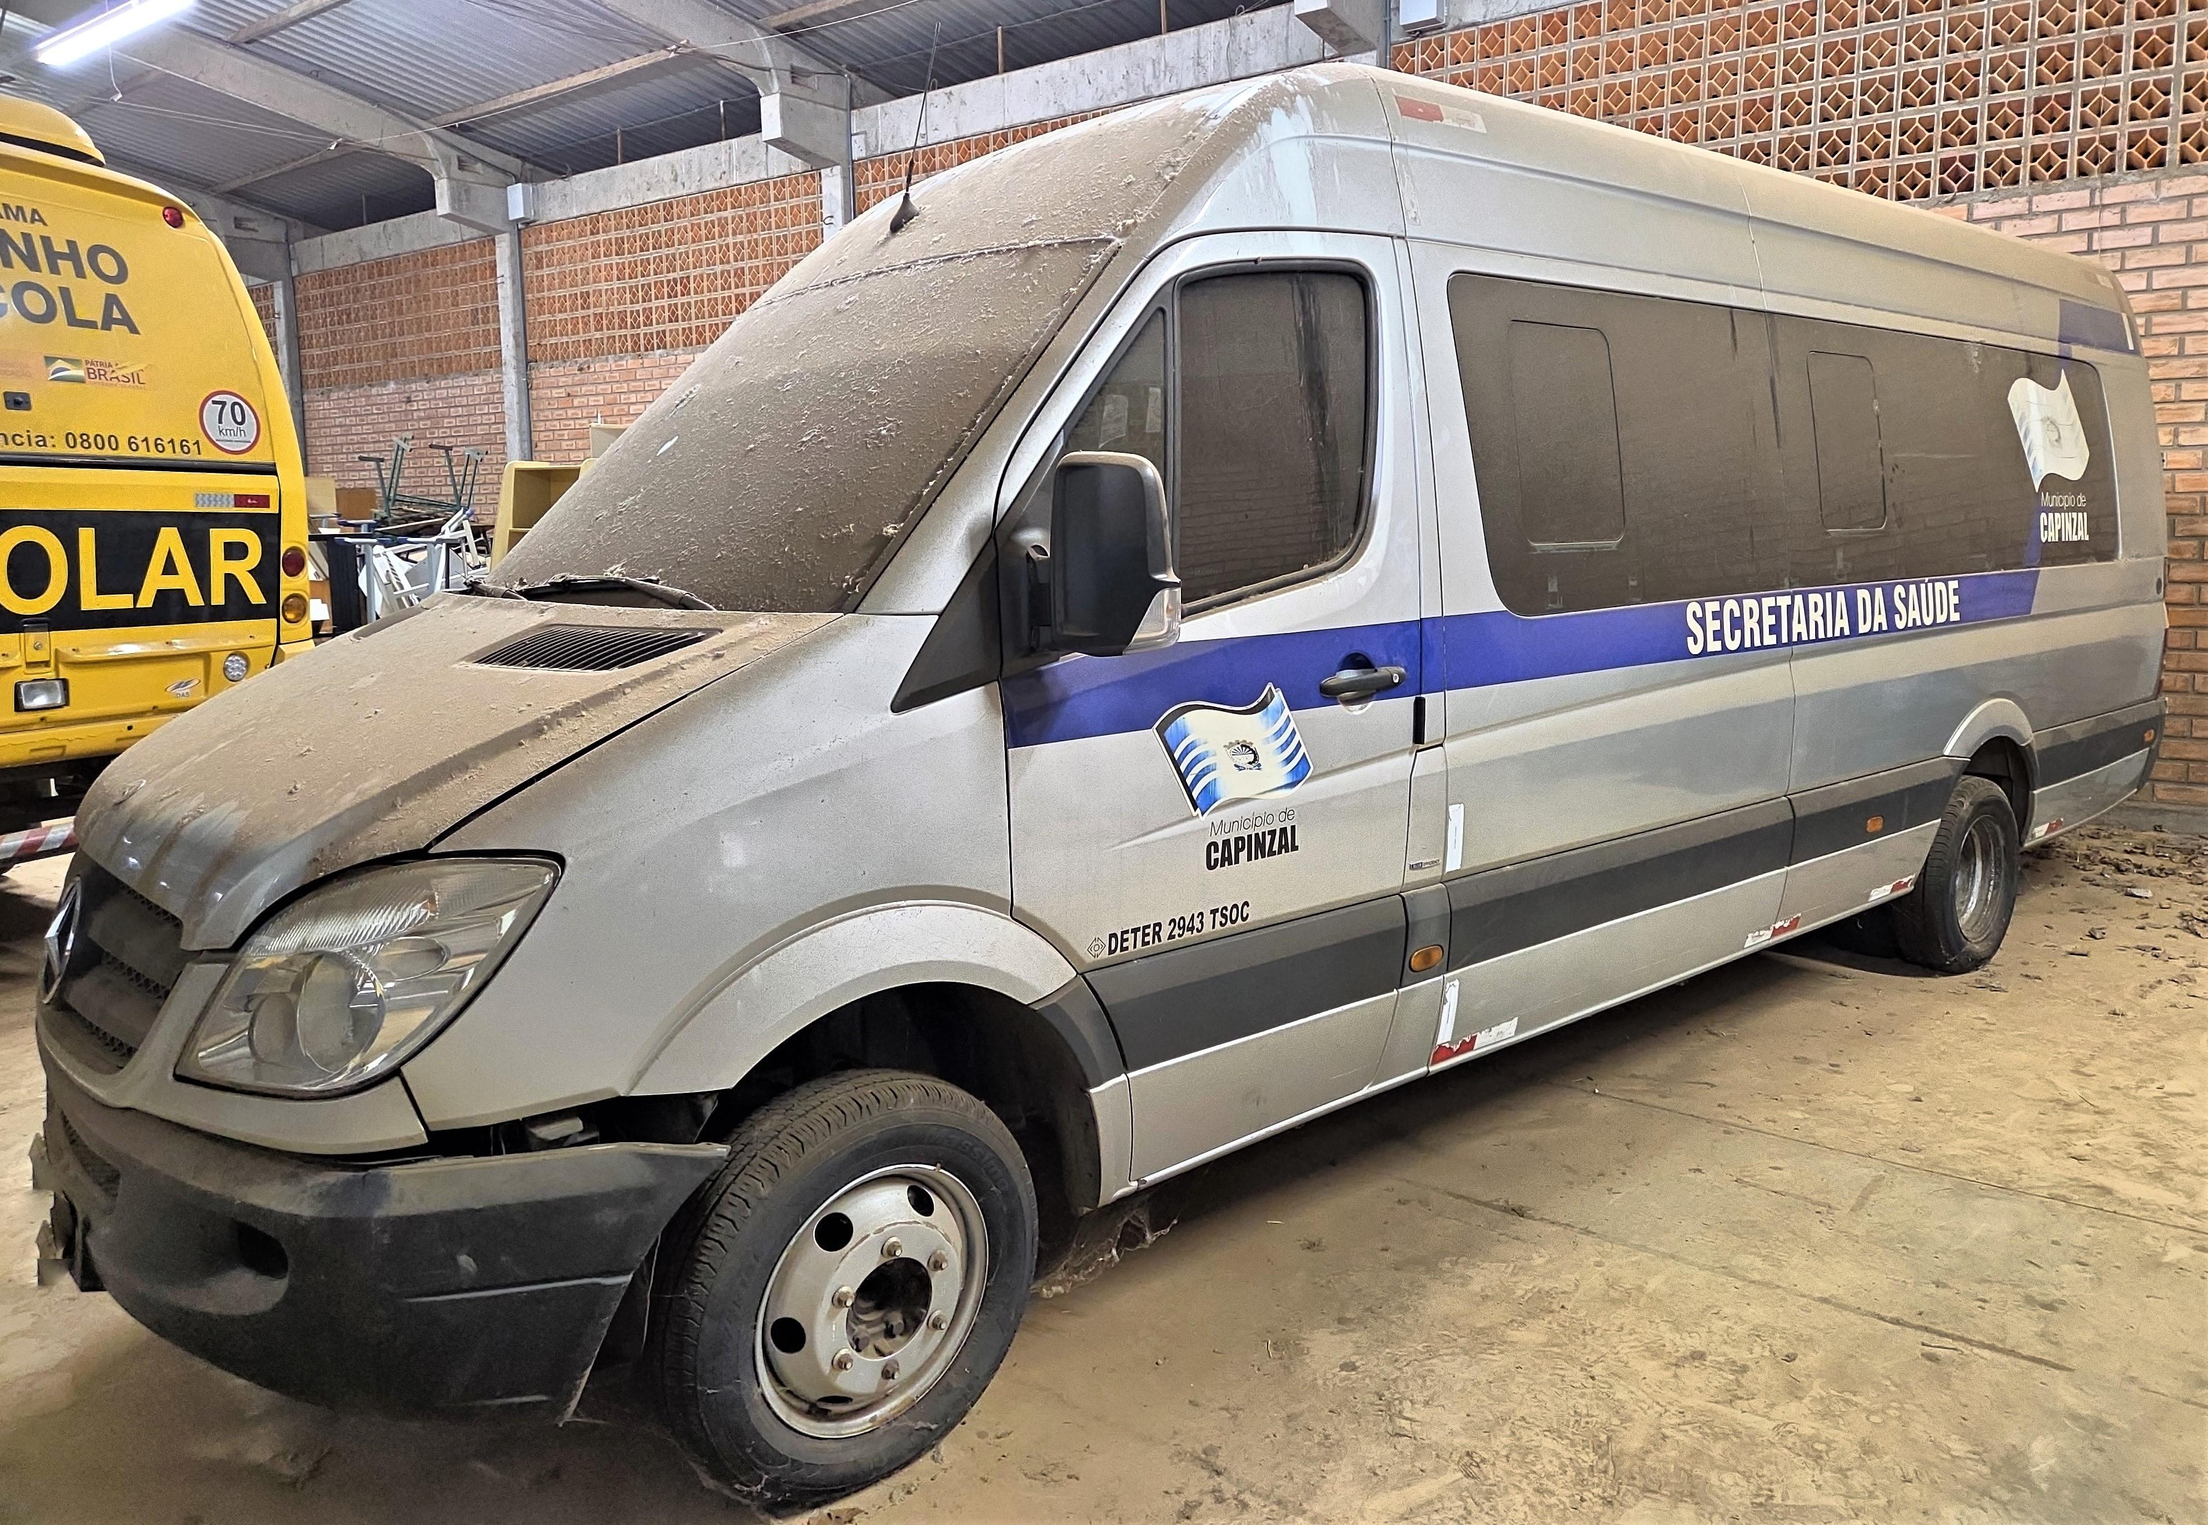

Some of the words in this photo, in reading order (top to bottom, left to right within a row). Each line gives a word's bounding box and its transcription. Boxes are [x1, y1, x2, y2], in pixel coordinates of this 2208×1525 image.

[0, 202, 48, 227] MA
[0, 280, 141, 336] OLA
[211, 400, 246, 426] 70
[65, 431, 119, 451] 0800
[127, 435, 202, 456] 616161
[218, 426, 247, 437] km/h
[2077, 492, 2087, 507] de
[2040, 511, 2090, 543] CAPINZAL
[0, 524, 267, 616] OLAR
[1686, 589, 1850, 656] SECRETARIA
[1856, 586, 1889, 635] DA
[1893, 578, 1961, 631] SAÚDE
[1278, 807, 1295, 823] de
[1205, 824, 1299, 871] CAPINZAL
[1107, 921, 1163, 956] DETER
[1167, 911, 1205, 941] 2943
[1209, 900, 1250, 930] TSOC
